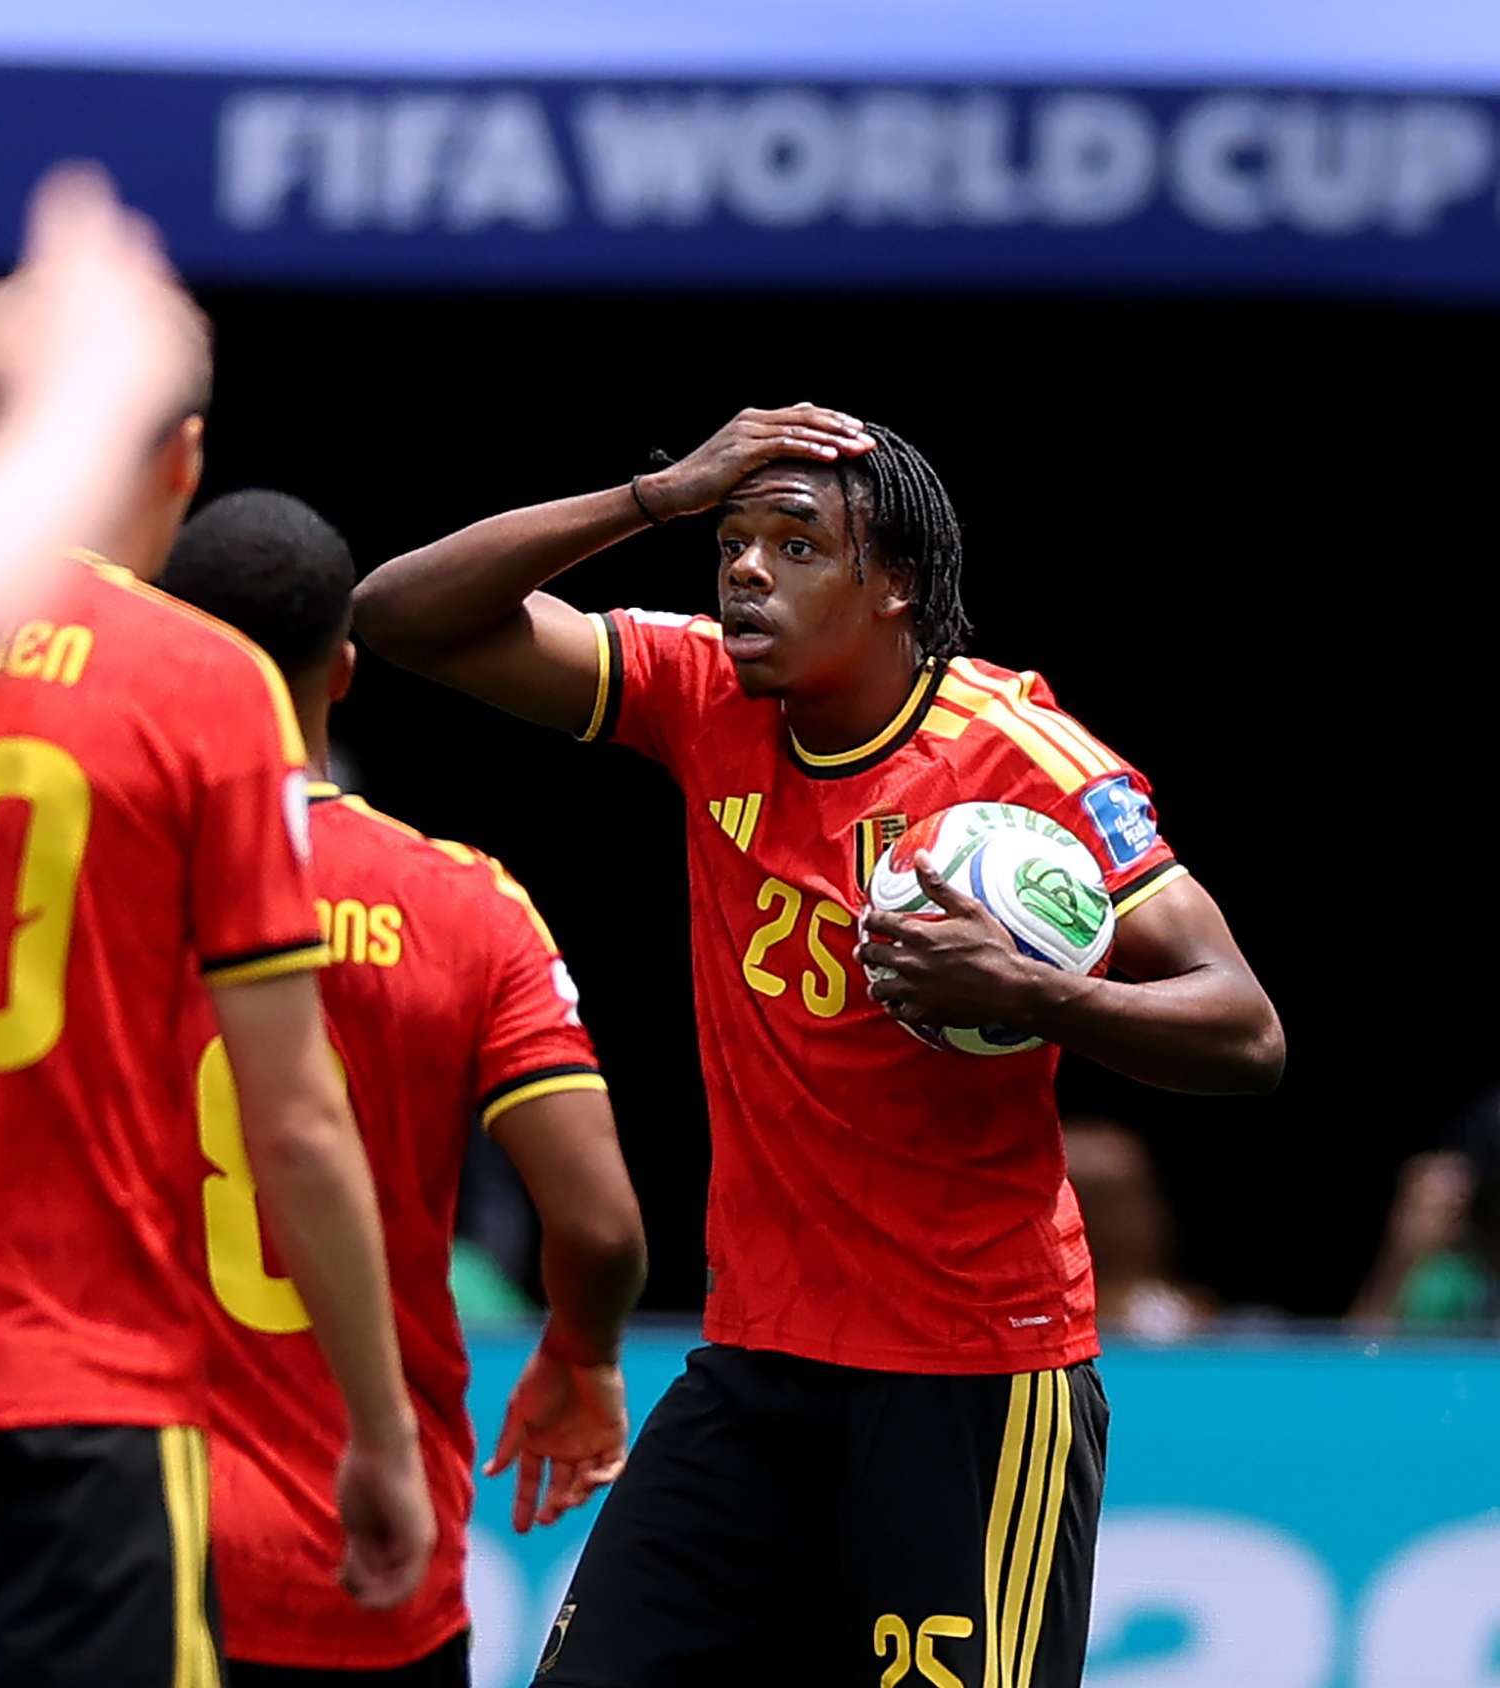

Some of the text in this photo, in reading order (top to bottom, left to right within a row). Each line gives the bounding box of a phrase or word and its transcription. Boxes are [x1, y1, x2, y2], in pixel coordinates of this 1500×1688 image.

[217, 92, 1490, 236] FIFA WORLD CUP
[742, 876, 852, 1018] 25
[873, 1613, 974, 1688] 25
